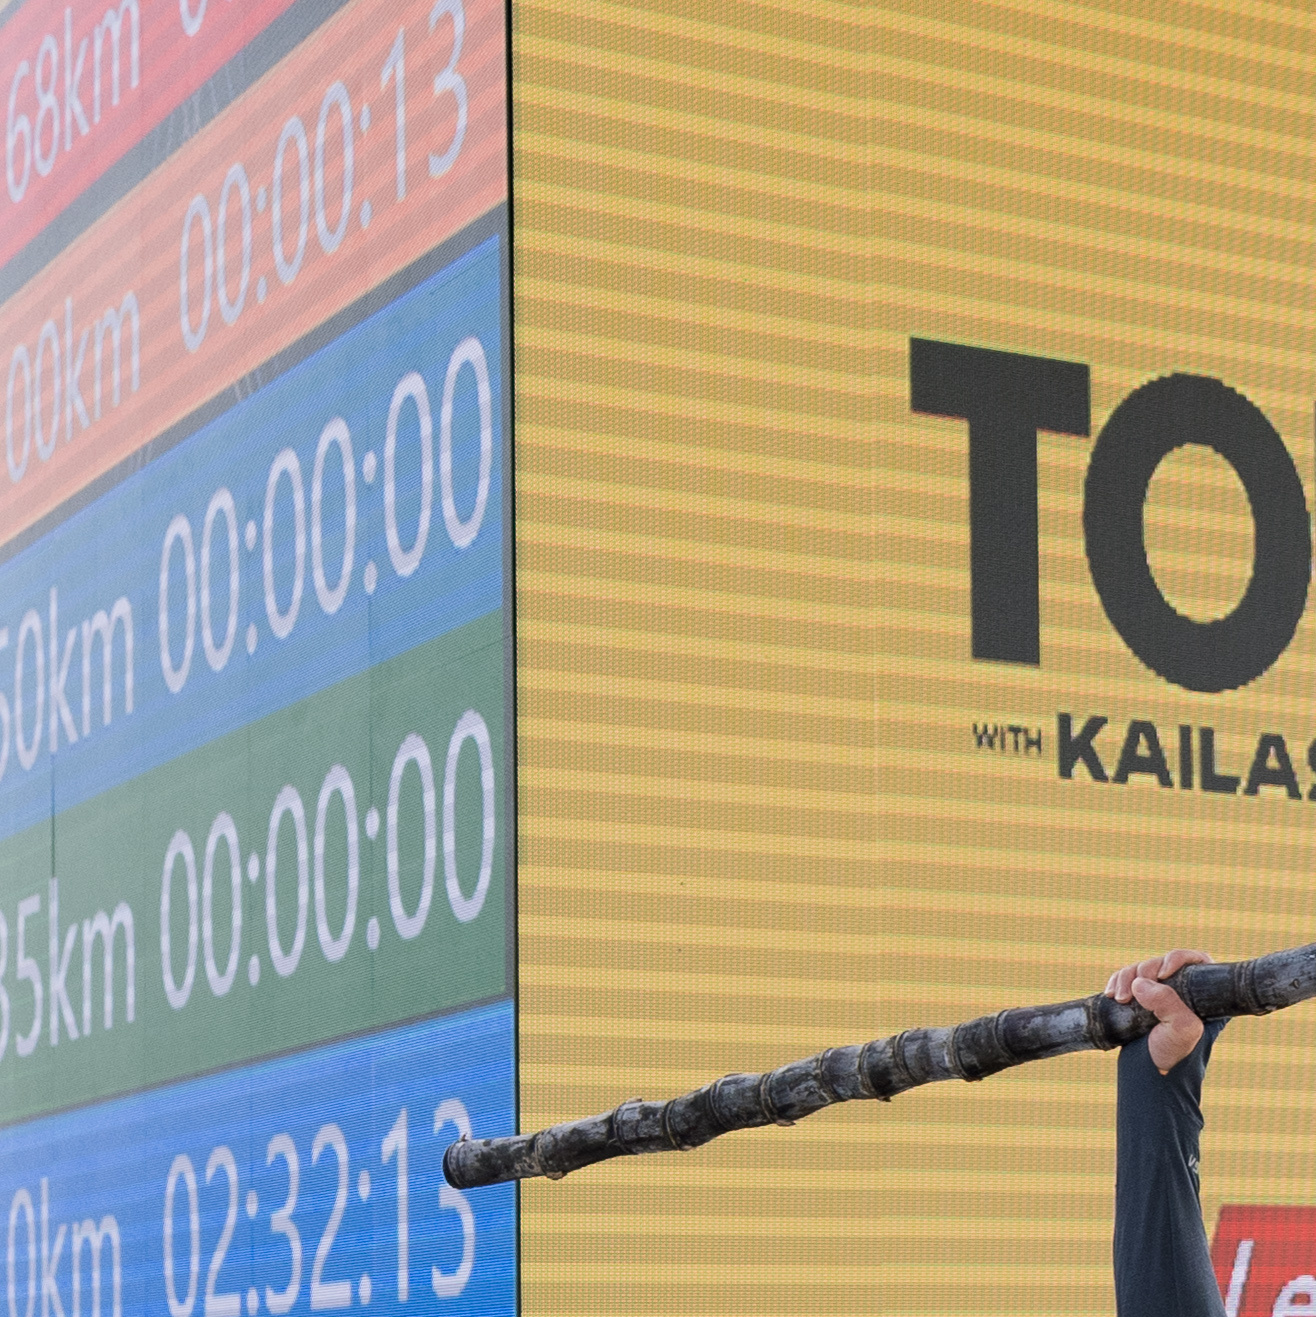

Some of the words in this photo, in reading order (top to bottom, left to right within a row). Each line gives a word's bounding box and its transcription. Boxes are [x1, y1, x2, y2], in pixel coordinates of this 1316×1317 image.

[180, 0, 469, 353] 00:00:13
[158, 336, 493, 694] 00:00:00
[160, 709, 496, 1011] 00:00:00
[972, 722, 1042, 756] WITH
